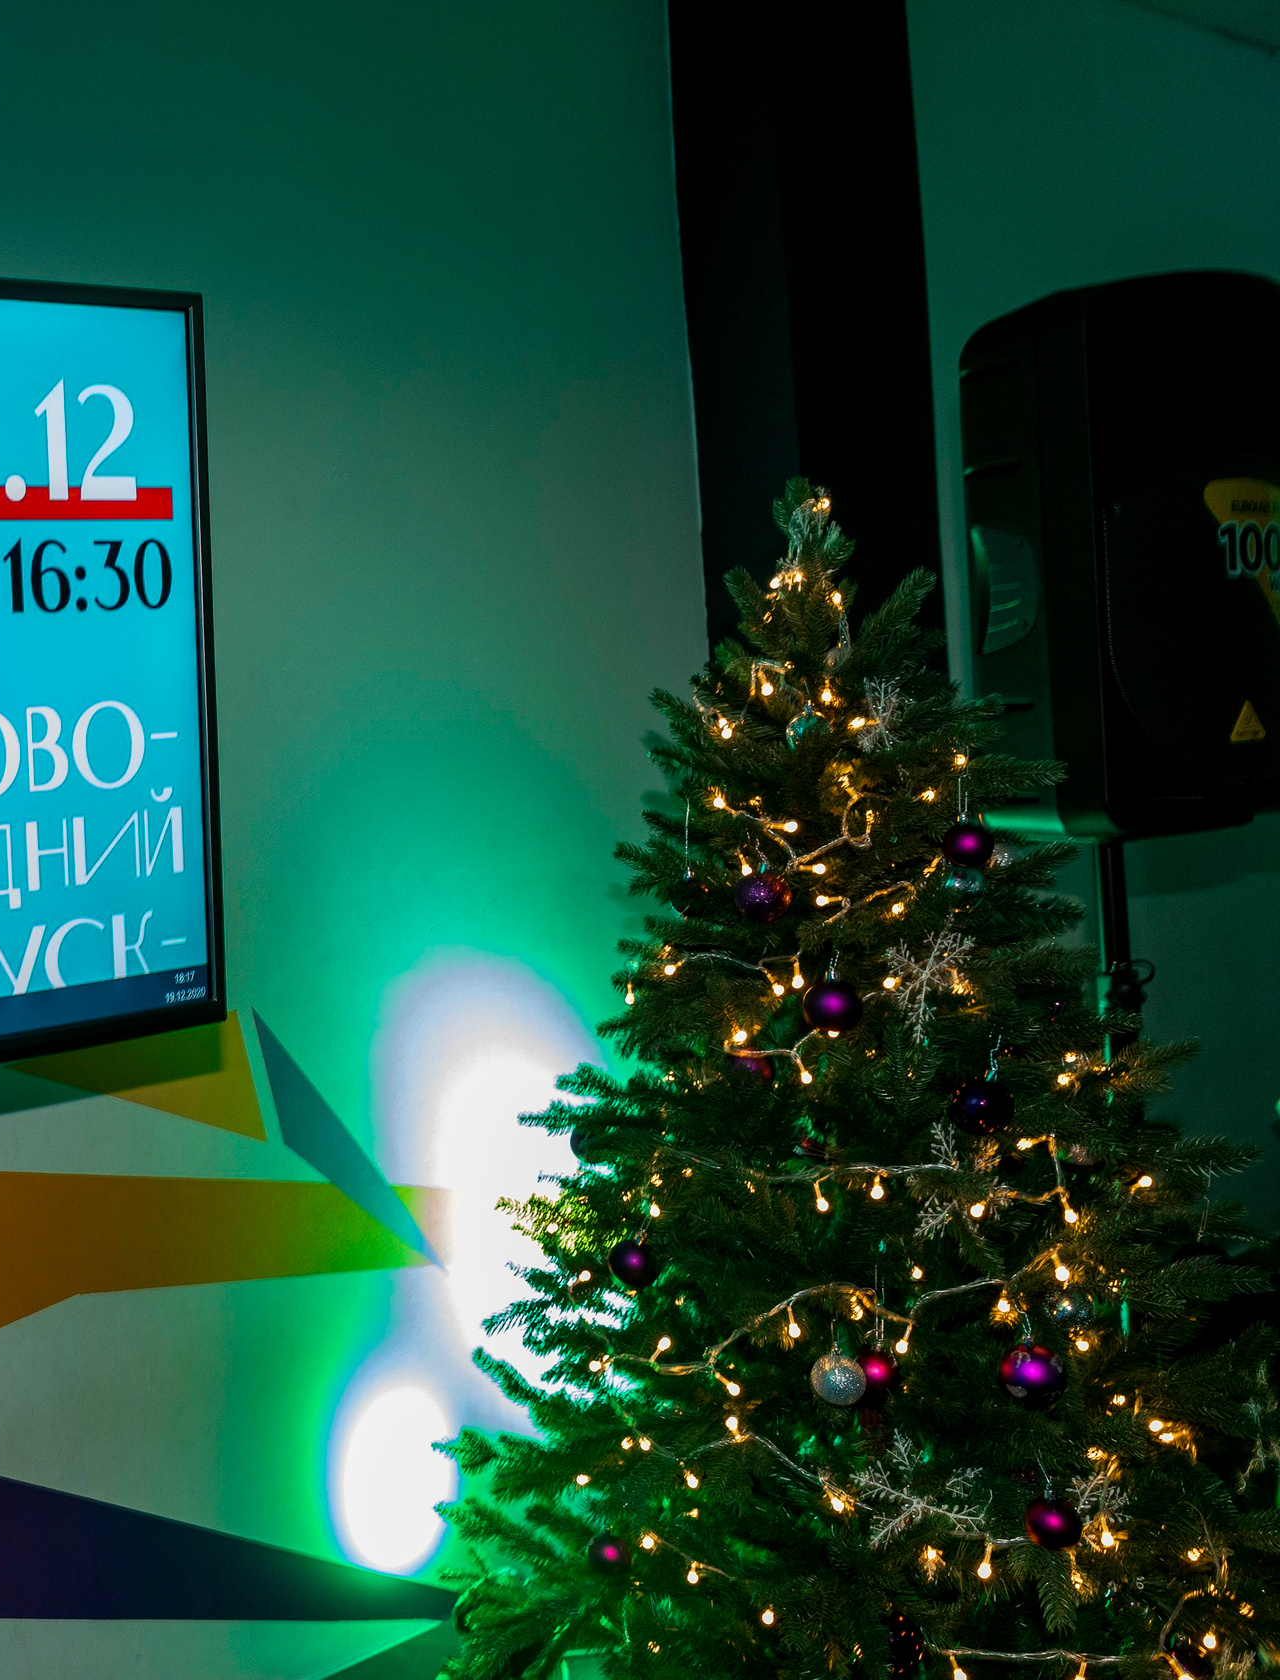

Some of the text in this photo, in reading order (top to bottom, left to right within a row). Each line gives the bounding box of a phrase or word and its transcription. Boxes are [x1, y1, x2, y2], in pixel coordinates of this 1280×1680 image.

[3, 537, 172, 614] 16:30
[174, 970, 195, 984] 18:17
[165, 986, 206, 1004] 19.12.2020
